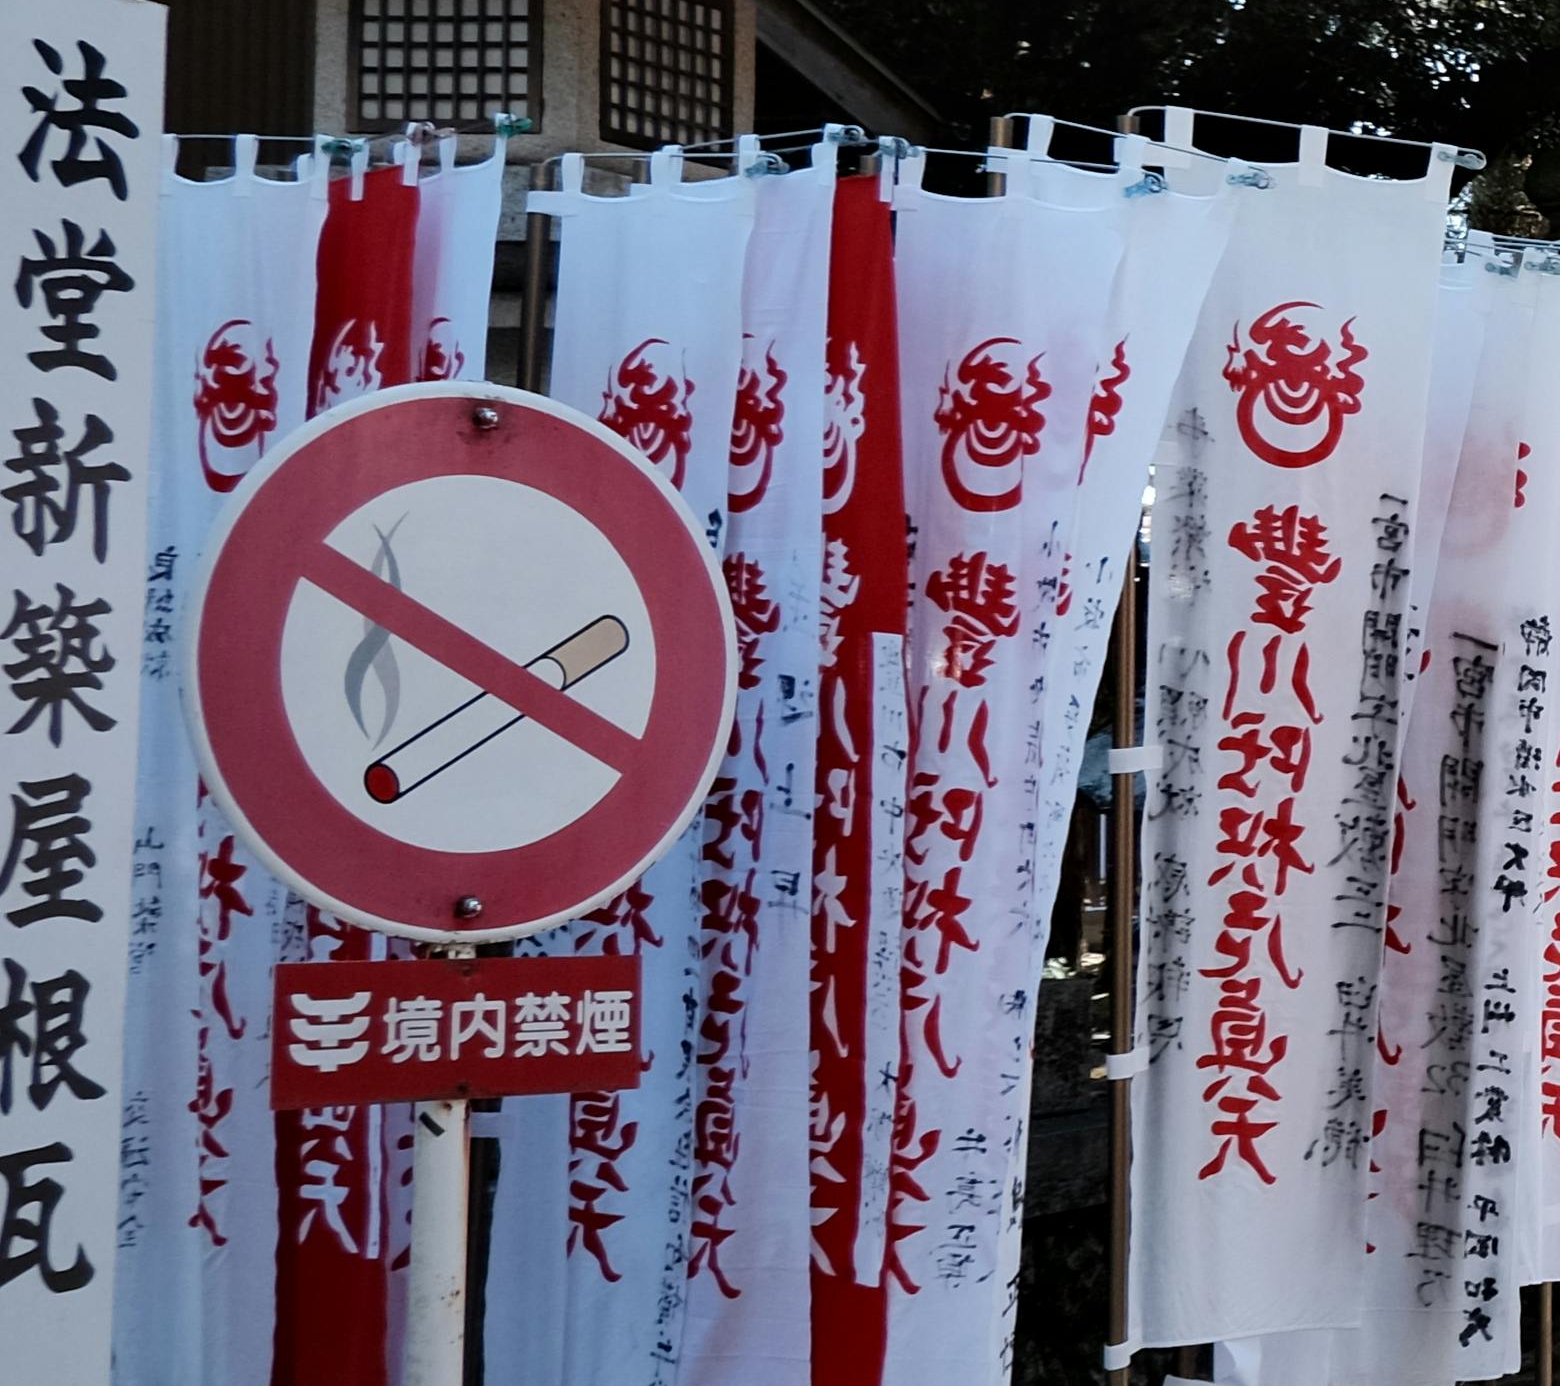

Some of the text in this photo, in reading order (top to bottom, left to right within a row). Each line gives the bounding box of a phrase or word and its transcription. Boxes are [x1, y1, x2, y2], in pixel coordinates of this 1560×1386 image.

[0, 37, 139, 1293] 法堂新築屋根瓦
[381, 989, 634, 1063] 境内禁煙
